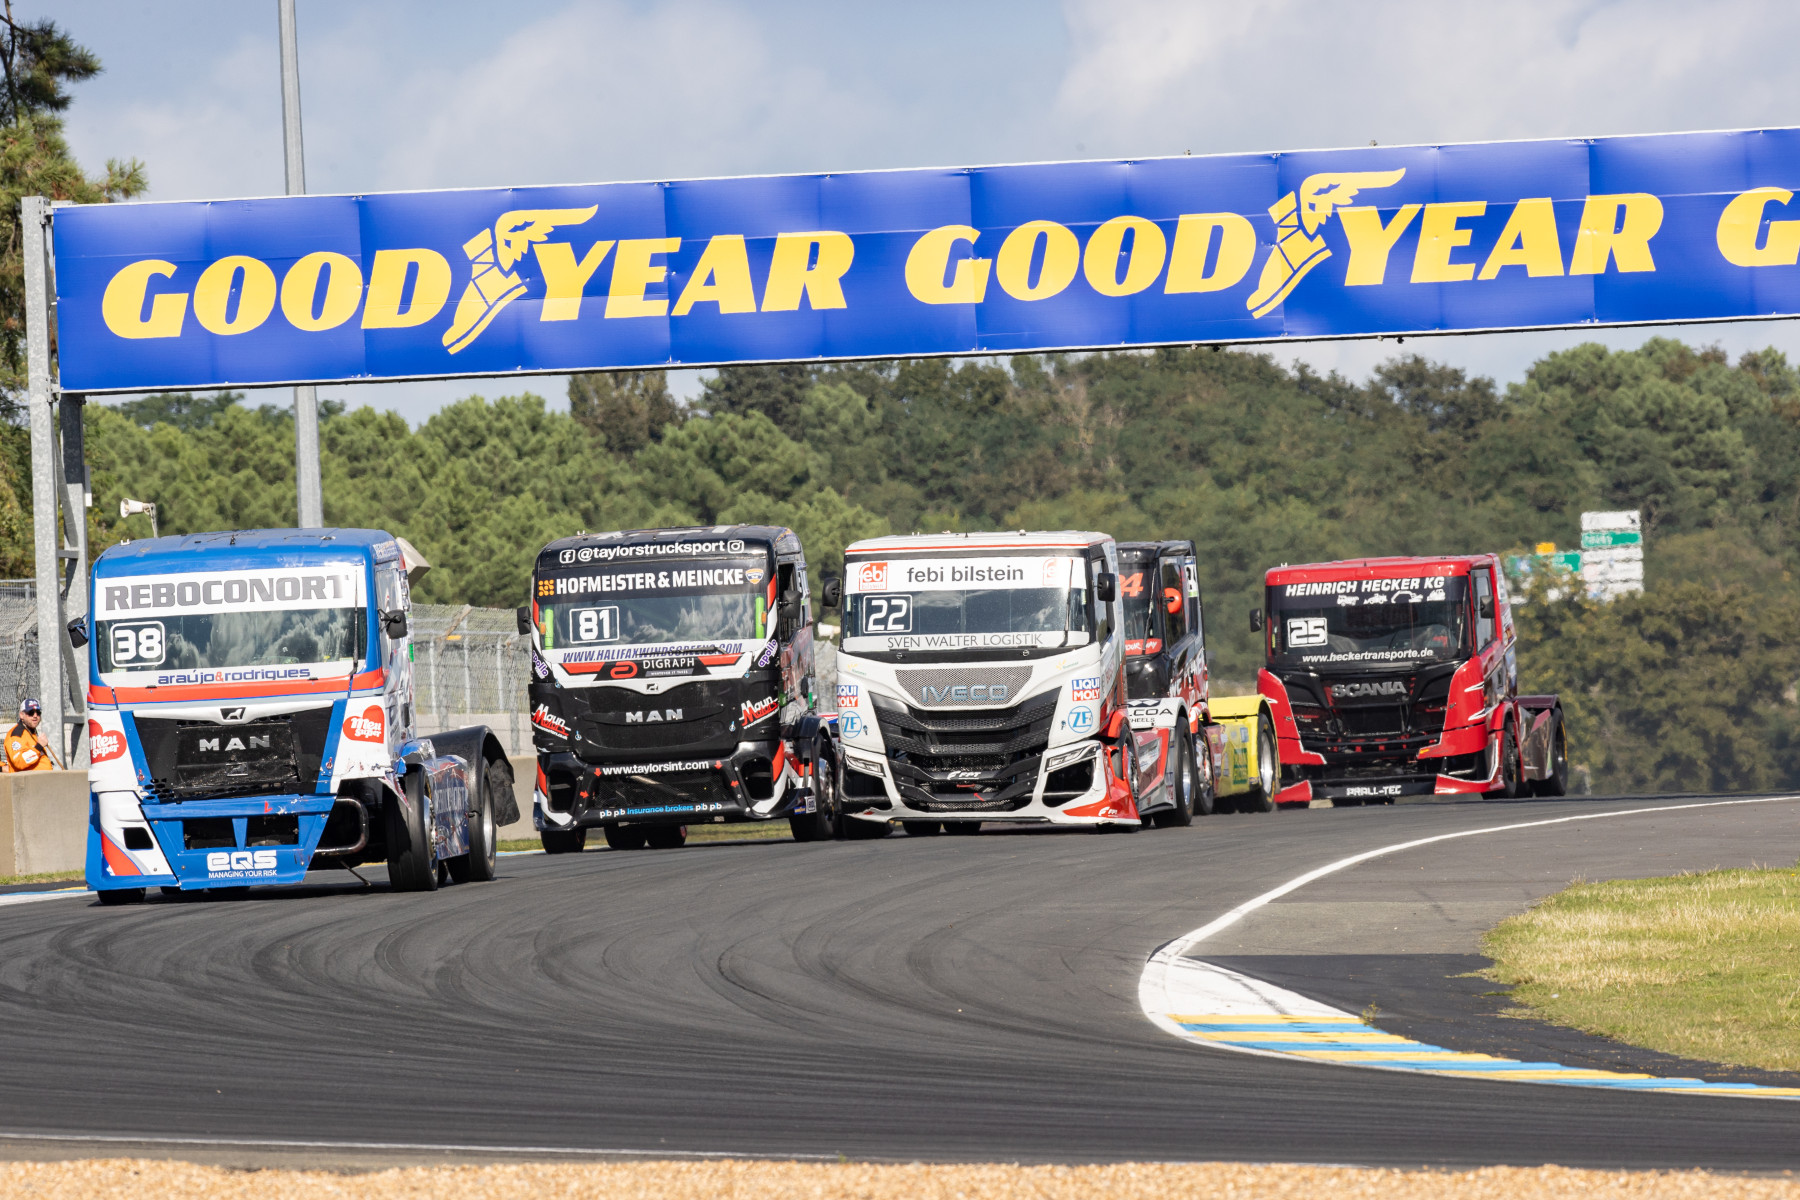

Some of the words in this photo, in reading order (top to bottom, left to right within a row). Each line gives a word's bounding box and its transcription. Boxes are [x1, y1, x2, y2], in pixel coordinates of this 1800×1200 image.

[577, 540, 726, 562] @taylorstrucksport
[556, 573, 657, 595] HOFMEISTER
[657, 571, 671, 589] &
[672, 568, 744, 588] MEINCKE
[907, 566, 944, 583] febi
[951, 564, 1024, 582] bilstein
[105, 574, 350, 611] REBOCONORT
[1285, 580, 1358, 597] HEINRICH
[1361, 577, 1420, 593] HECKER
[1424, 576, 1445, 590] KG
[867, 598, 908, 631] 22
[579, 609, 610, 641] 81
[1290, 620, 1326, 645] 25
[114, 627, 162, 661] 38
[887, 636, 921, 648] SVEN
[925, 635, 978, 647] WALTER
[983, 633, 1043, 646] LOGISTIK
[758, 639, 777, 667] apollo
[1302, 647, 1434, 663] www.heckertransporte.de
[642, 657, 695, 670] DIGRAPH
[1073, 677, 1100, 690] LIQUI
[1331, 681, 1408, 698] SCANIA
[921, 684, 1009, 702] IVECO
[1073, 688, 1100, 701] MOLY
[626, 708, 683, 723] MAN
[1069, 711, 1092, 728] ZF
[842, 716, 861, 733] ZF
[199, 735, 271, 752] MAN
[602, 760, 710, 775] www.taylorsint.com
[599, 810, 613, 819] pib
[613, 808, 626, 818] pib
[627, 806, 664, 815] insurance
[665, 804, 694, 812] brokers
[695, 803, 708, 812] pib
[709, 802, 723, 811] pib
[208, 871, 244, 879] MANAGING
[245, 870, 261, 878] YOUR
[263, 869, 278, 877] RISK
